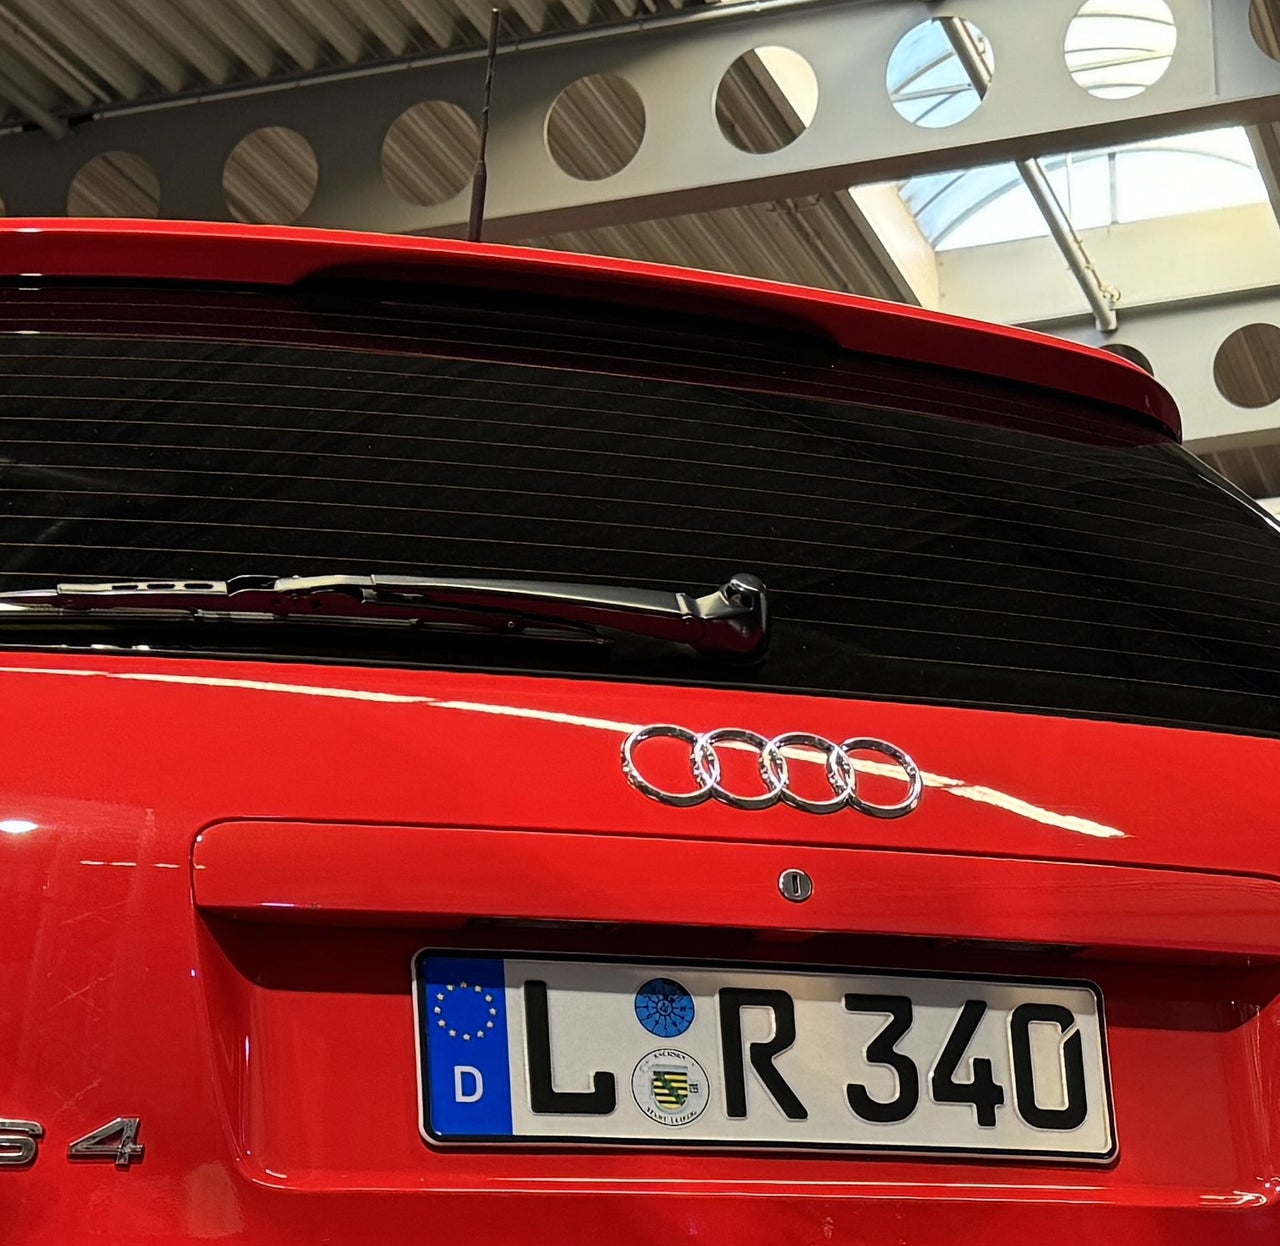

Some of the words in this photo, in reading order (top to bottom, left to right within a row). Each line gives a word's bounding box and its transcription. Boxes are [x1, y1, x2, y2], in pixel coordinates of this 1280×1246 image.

[523, 979, 618, 1116] L
[718, 986, 809, 1120] R
[843, 991, 1089, 1130] 340
[454, 1066, 484, 1103] D
[67, 1116, 143, 1166] 4
